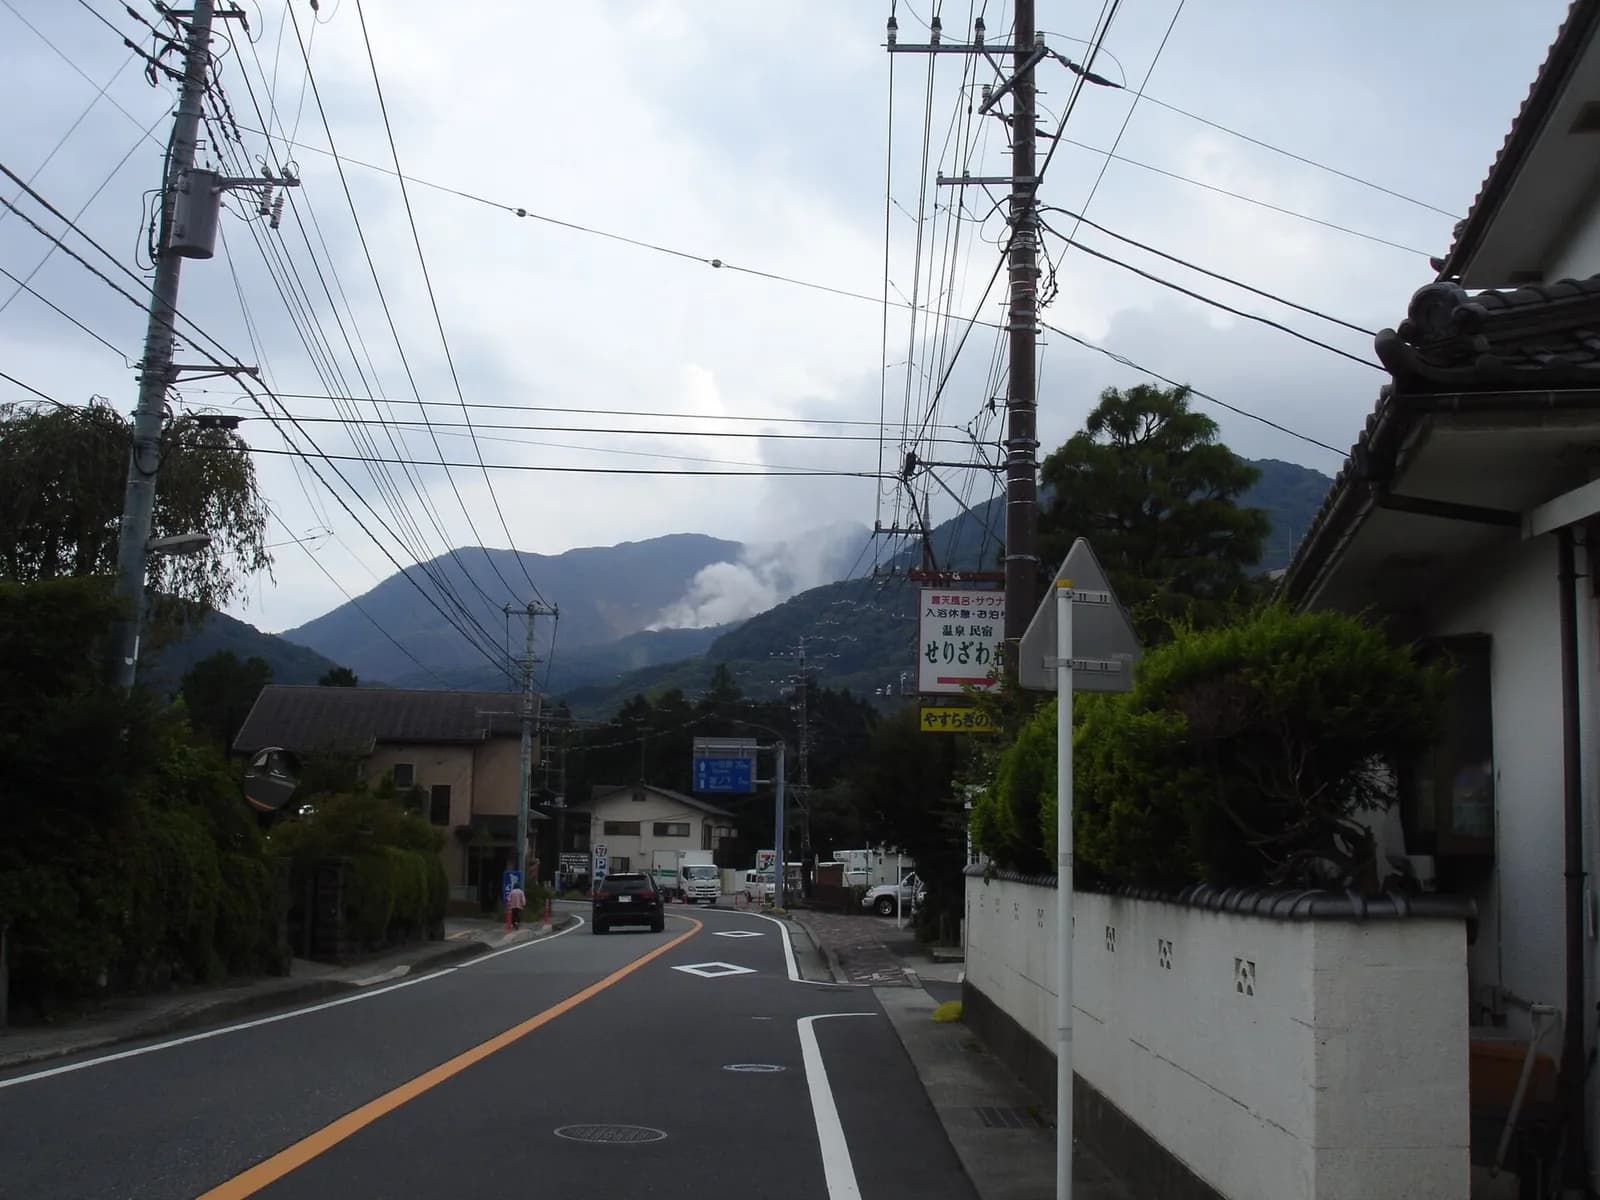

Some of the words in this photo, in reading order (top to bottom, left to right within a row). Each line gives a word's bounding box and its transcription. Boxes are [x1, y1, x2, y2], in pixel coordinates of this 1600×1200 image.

[942, 624, 966, 637] 温泉
[969, 624, 993, 637] 民宿
[597, 859, 605, 869] P
